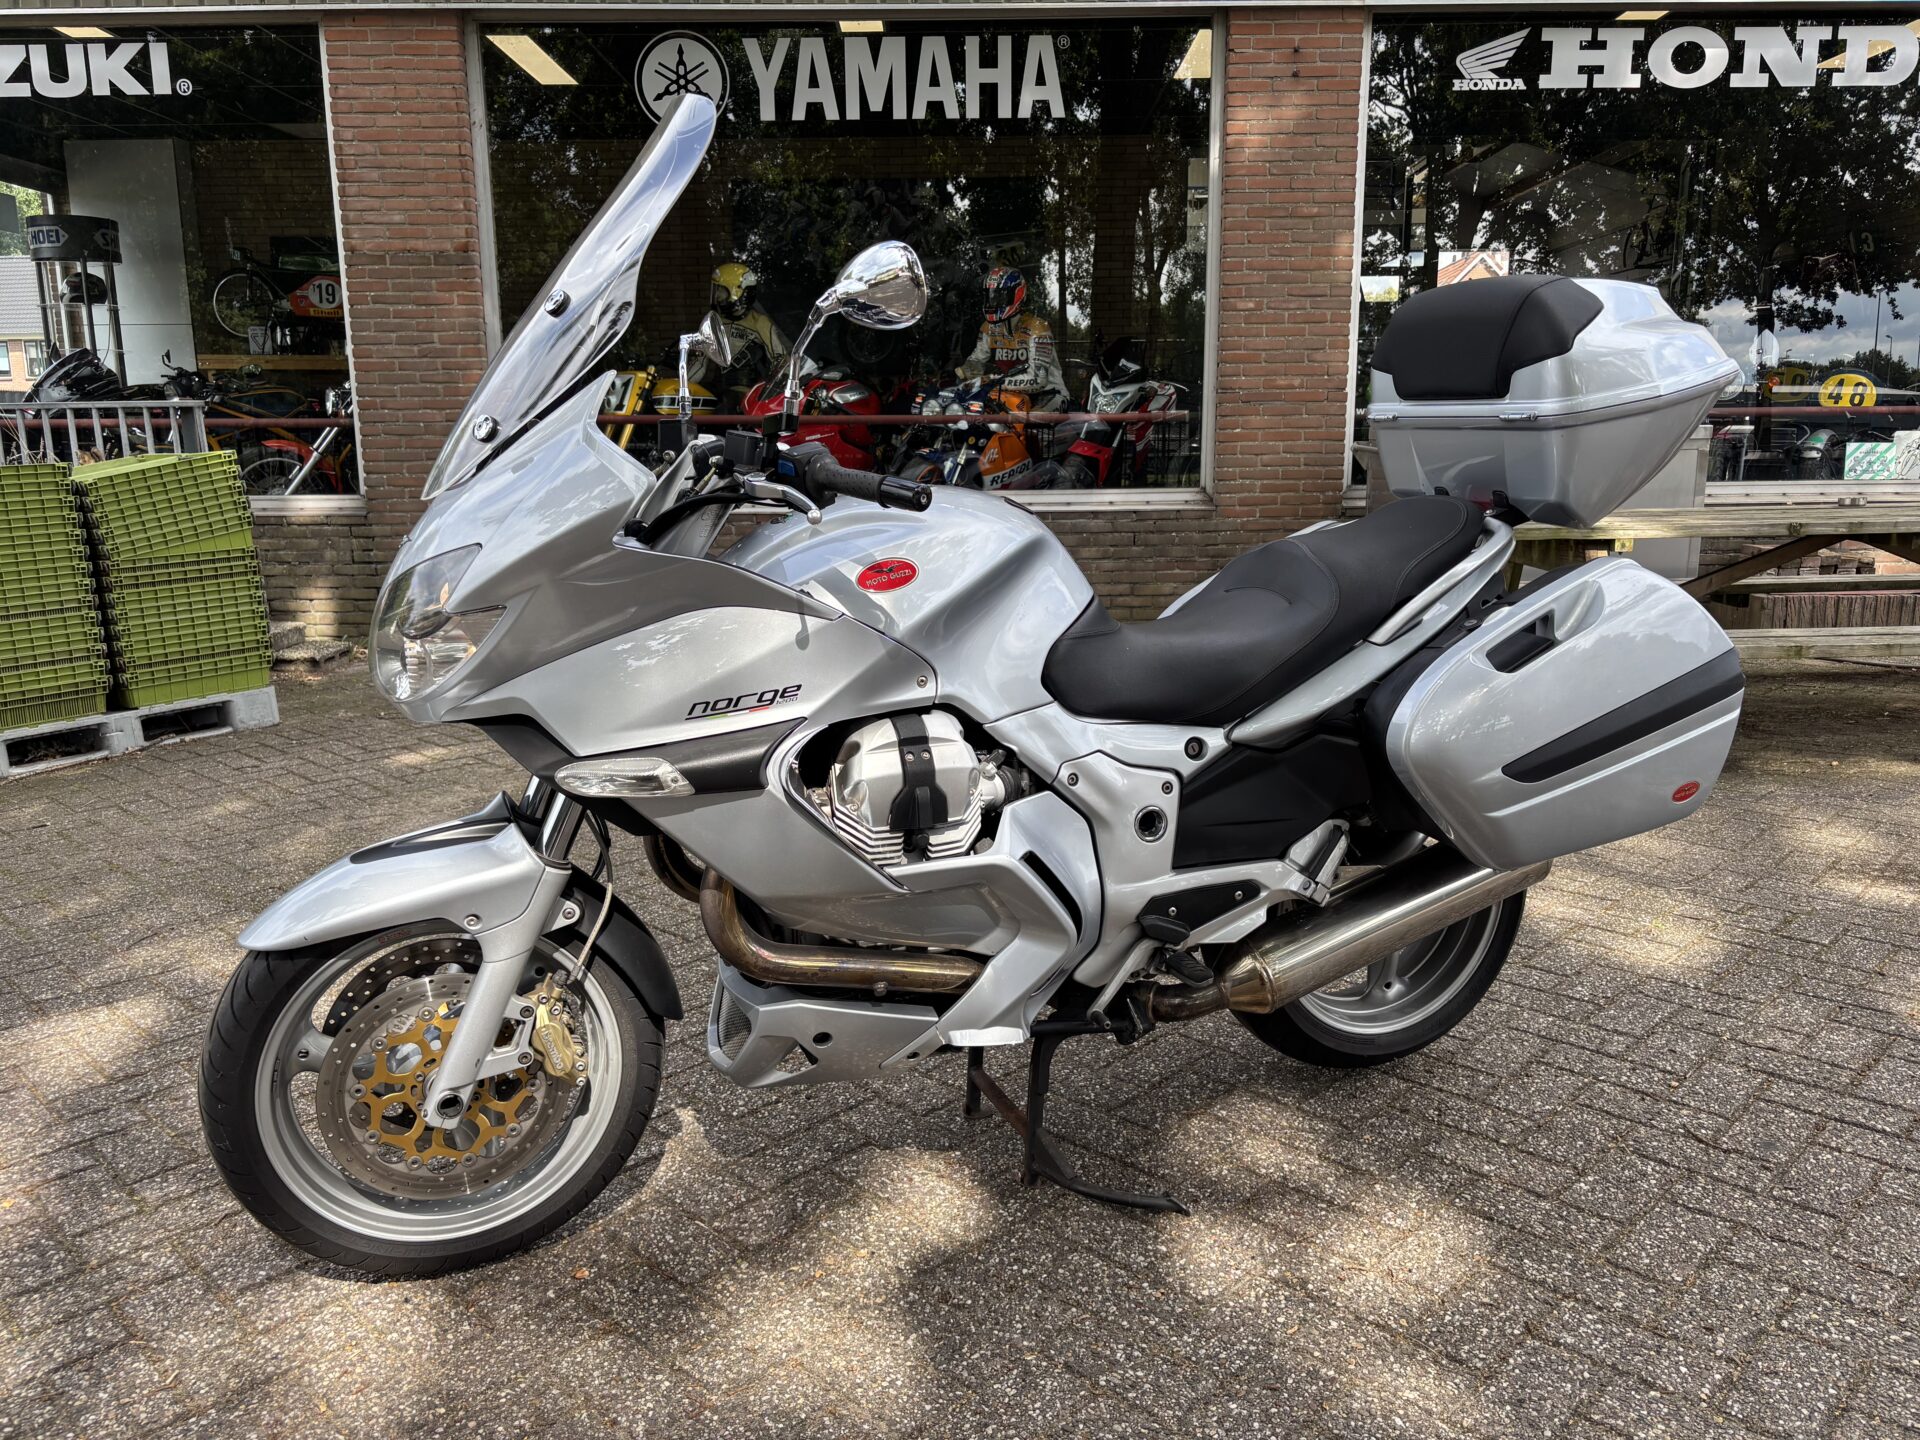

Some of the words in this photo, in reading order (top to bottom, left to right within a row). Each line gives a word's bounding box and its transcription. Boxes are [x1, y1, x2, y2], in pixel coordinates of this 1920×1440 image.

[1539, 26, 1920, 88] HOND
[742, 35, 1065, 121] YAMAHA
[1452, 78, 1527, 91] HONDA
[29, 229, 61, 246] HOEI
[1827, 378, 1868, 407] 48
[865, 575, 888, 587] MOTO
[889, 569, 913, 580] GUZZI
[685, 684, 802, 720] norge
